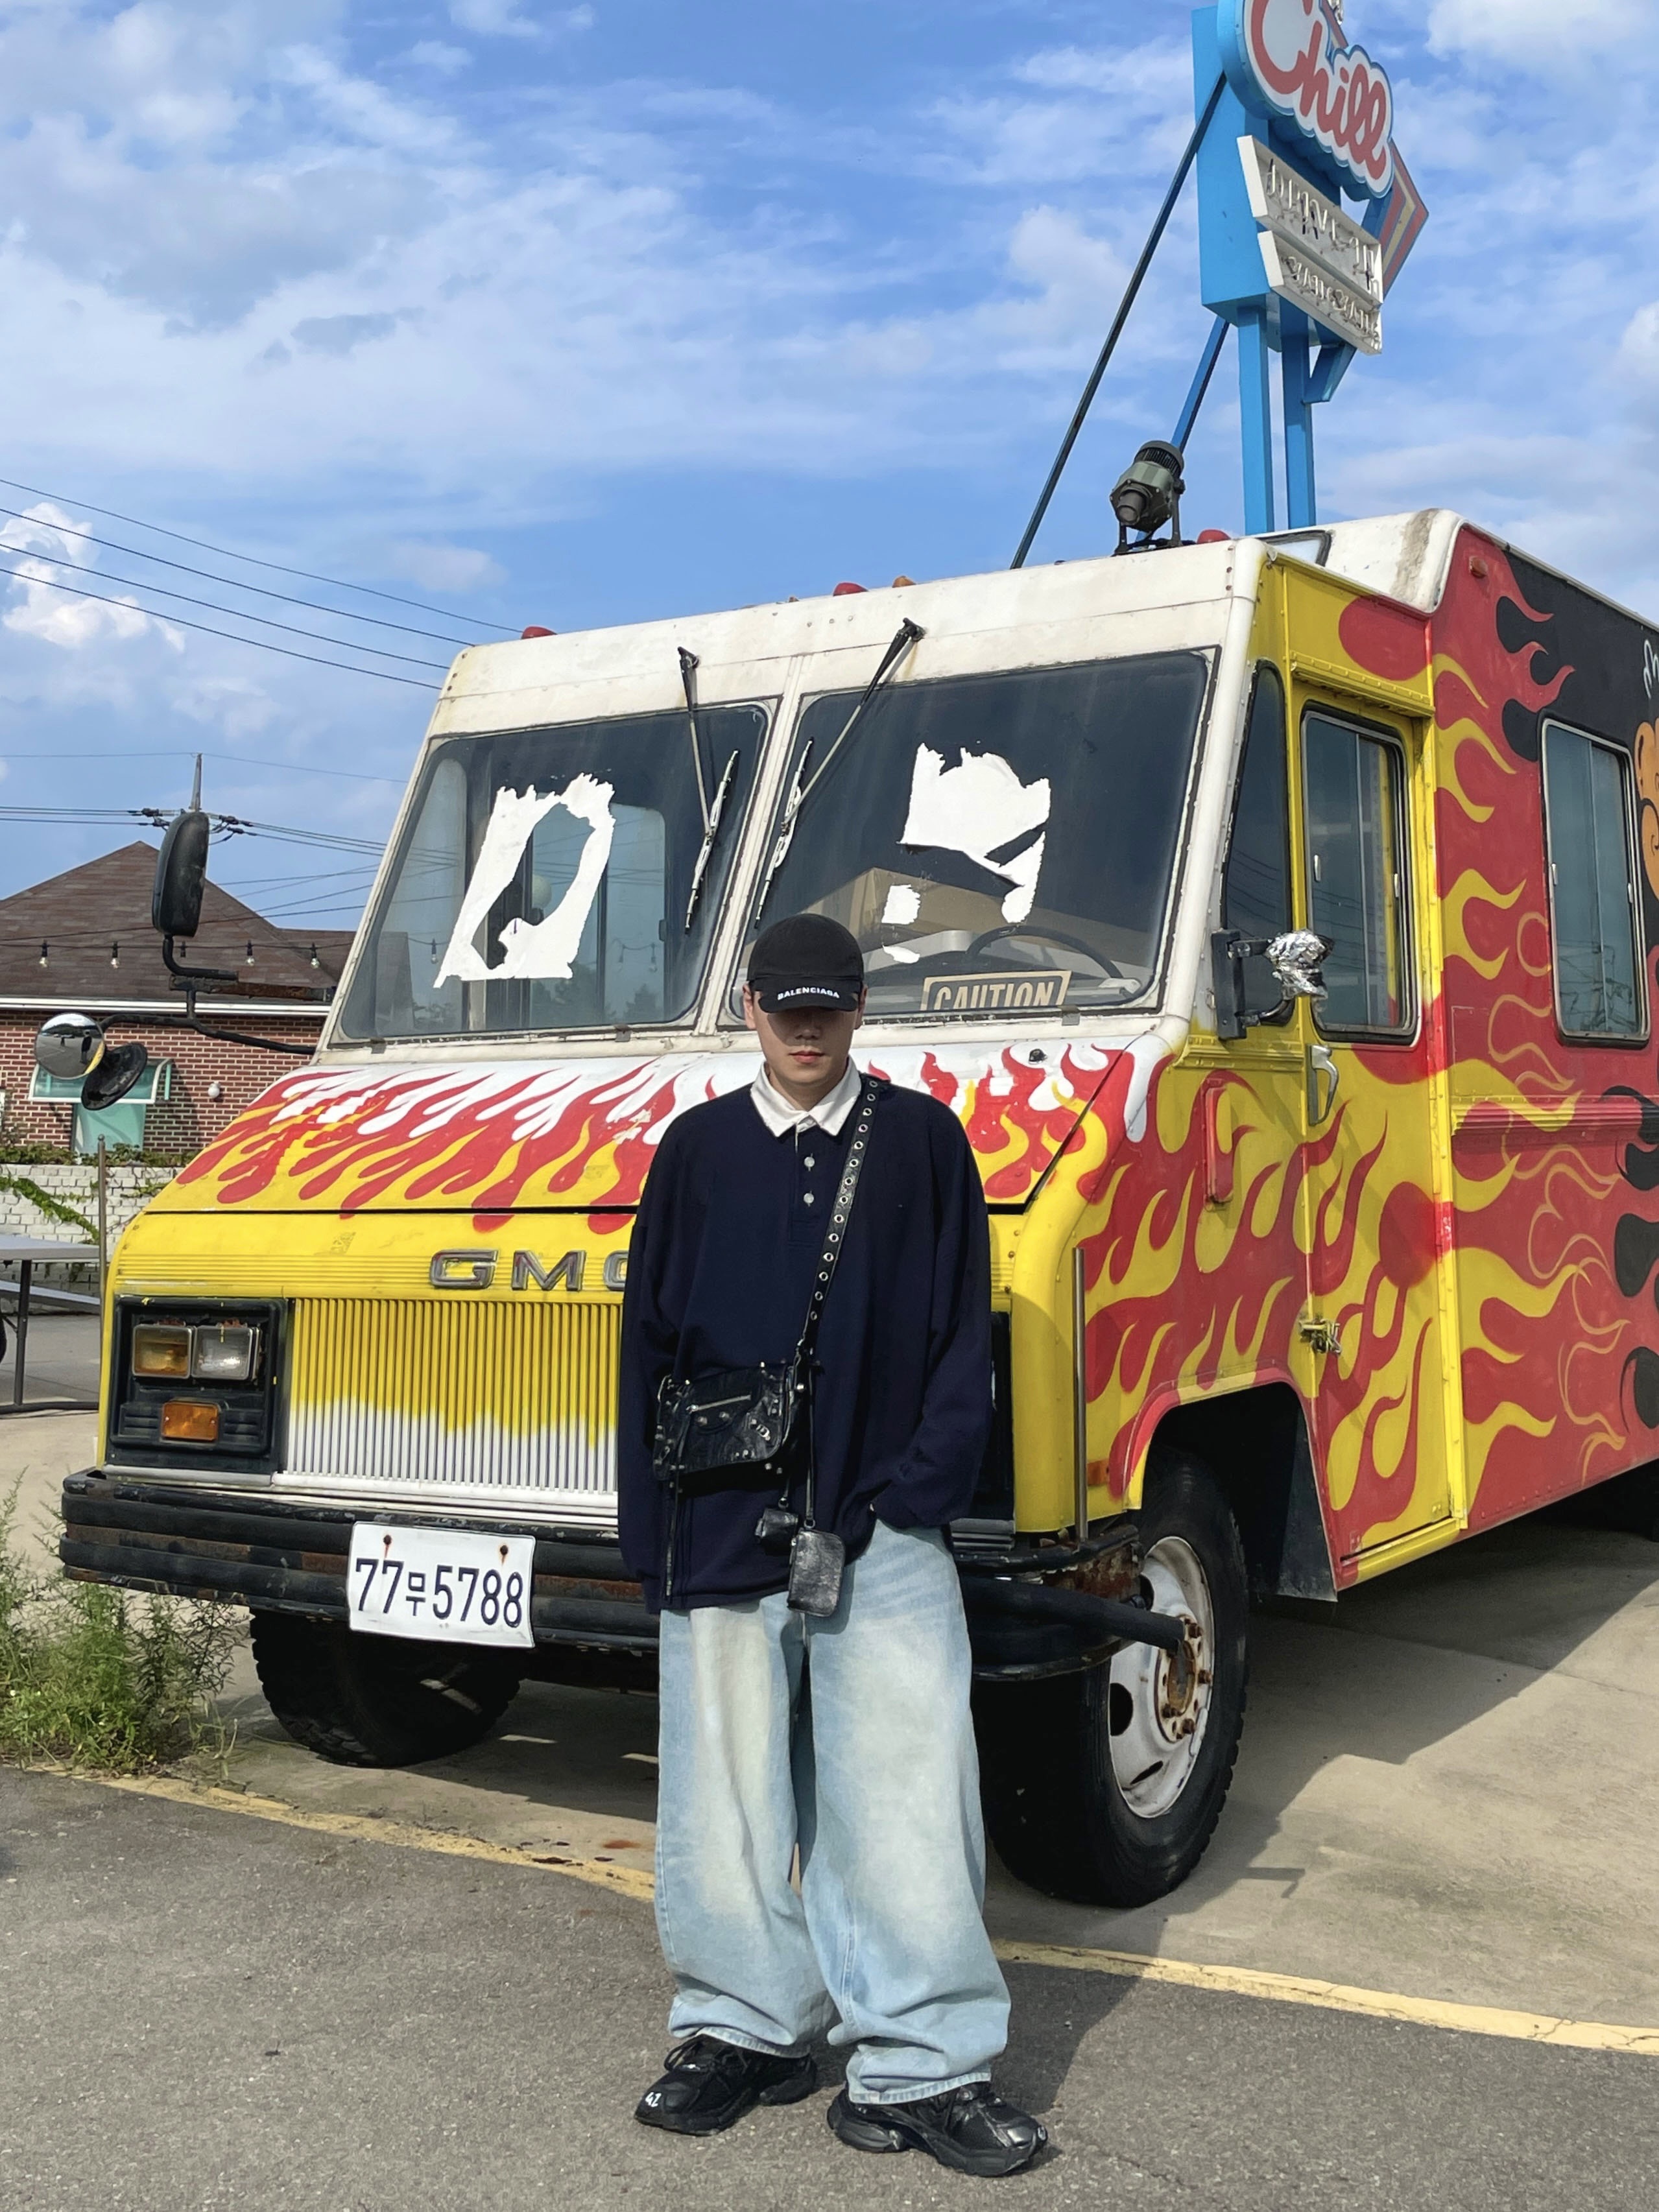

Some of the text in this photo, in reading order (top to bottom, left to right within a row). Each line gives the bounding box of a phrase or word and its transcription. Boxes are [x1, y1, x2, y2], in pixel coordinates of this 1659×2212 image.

[1251, 0, 1387, 180] Chill
[777, 987, 840, 1001] BALENCIAGA
[934, 982, 1055, 1010] CAUTION
[355, 1558, 524, 1628] 77무5788
